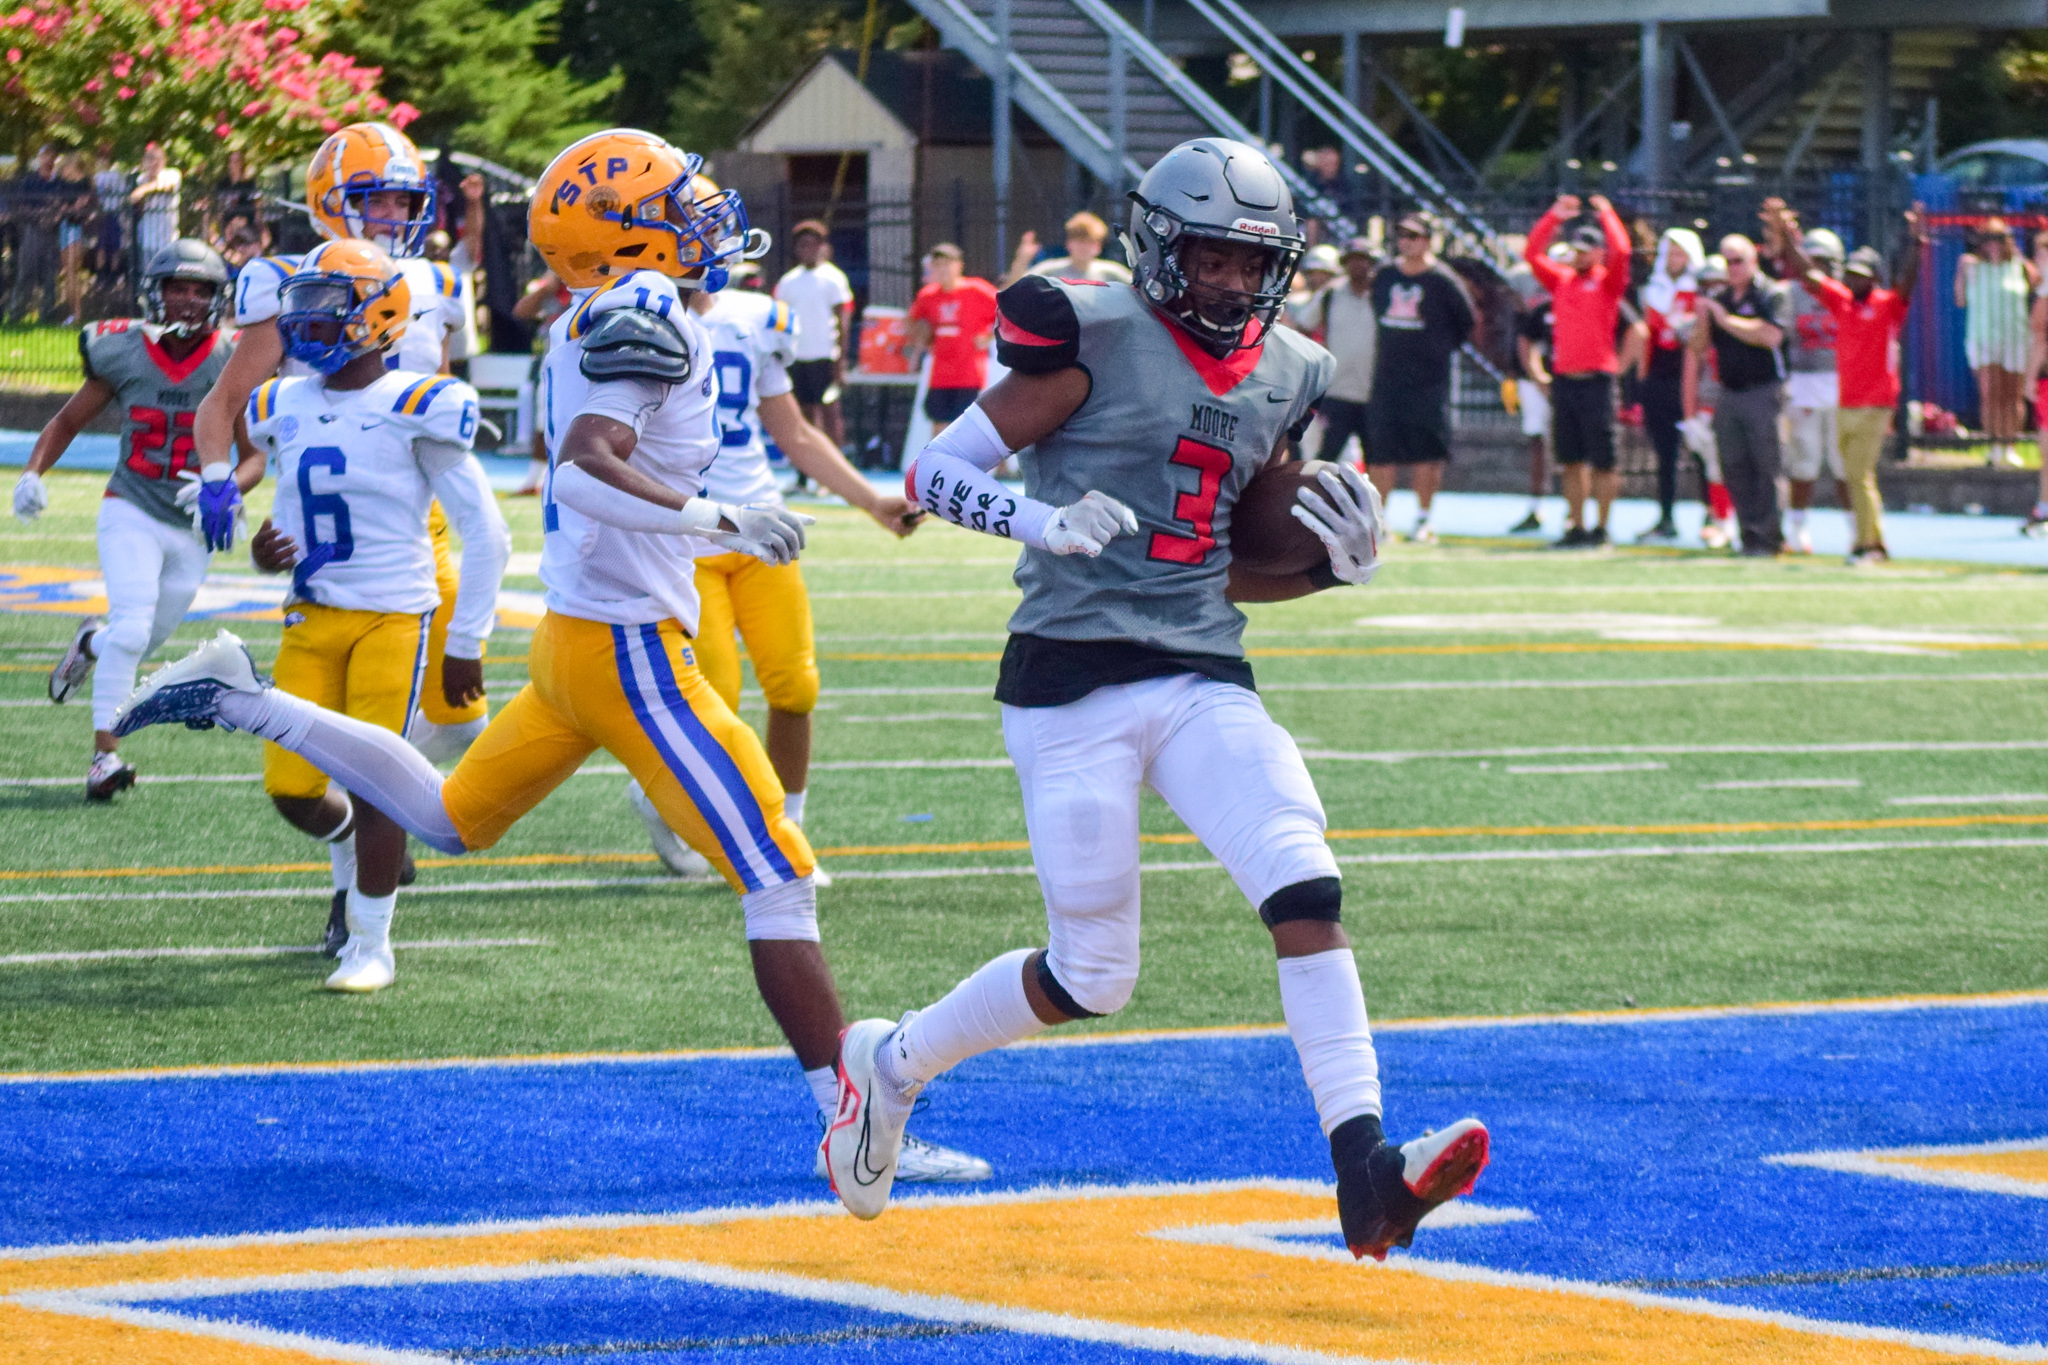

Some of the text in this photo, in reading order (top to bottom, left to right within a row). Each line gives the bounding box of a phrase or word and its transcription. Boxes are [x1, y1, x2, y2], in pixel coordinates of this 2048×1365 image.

[557, 157, 629, 207] STP
[1239, 222, 1277, 236] Riddell
[634, 287, 674, 320] 11
[459, 399, 477, 440] 6
[1189, 403, 1240, 442] MOORE
[126, 405, 201, 481] 22
[297, 446, 355, 563] 6
[926, 470, 945, 517] HIS
[948, 480, 973, 527] NE
[971, 493, 999, 531] OR
[1145, 434, 1234, 567] 3
[993, 499, 1016, 538] OU
